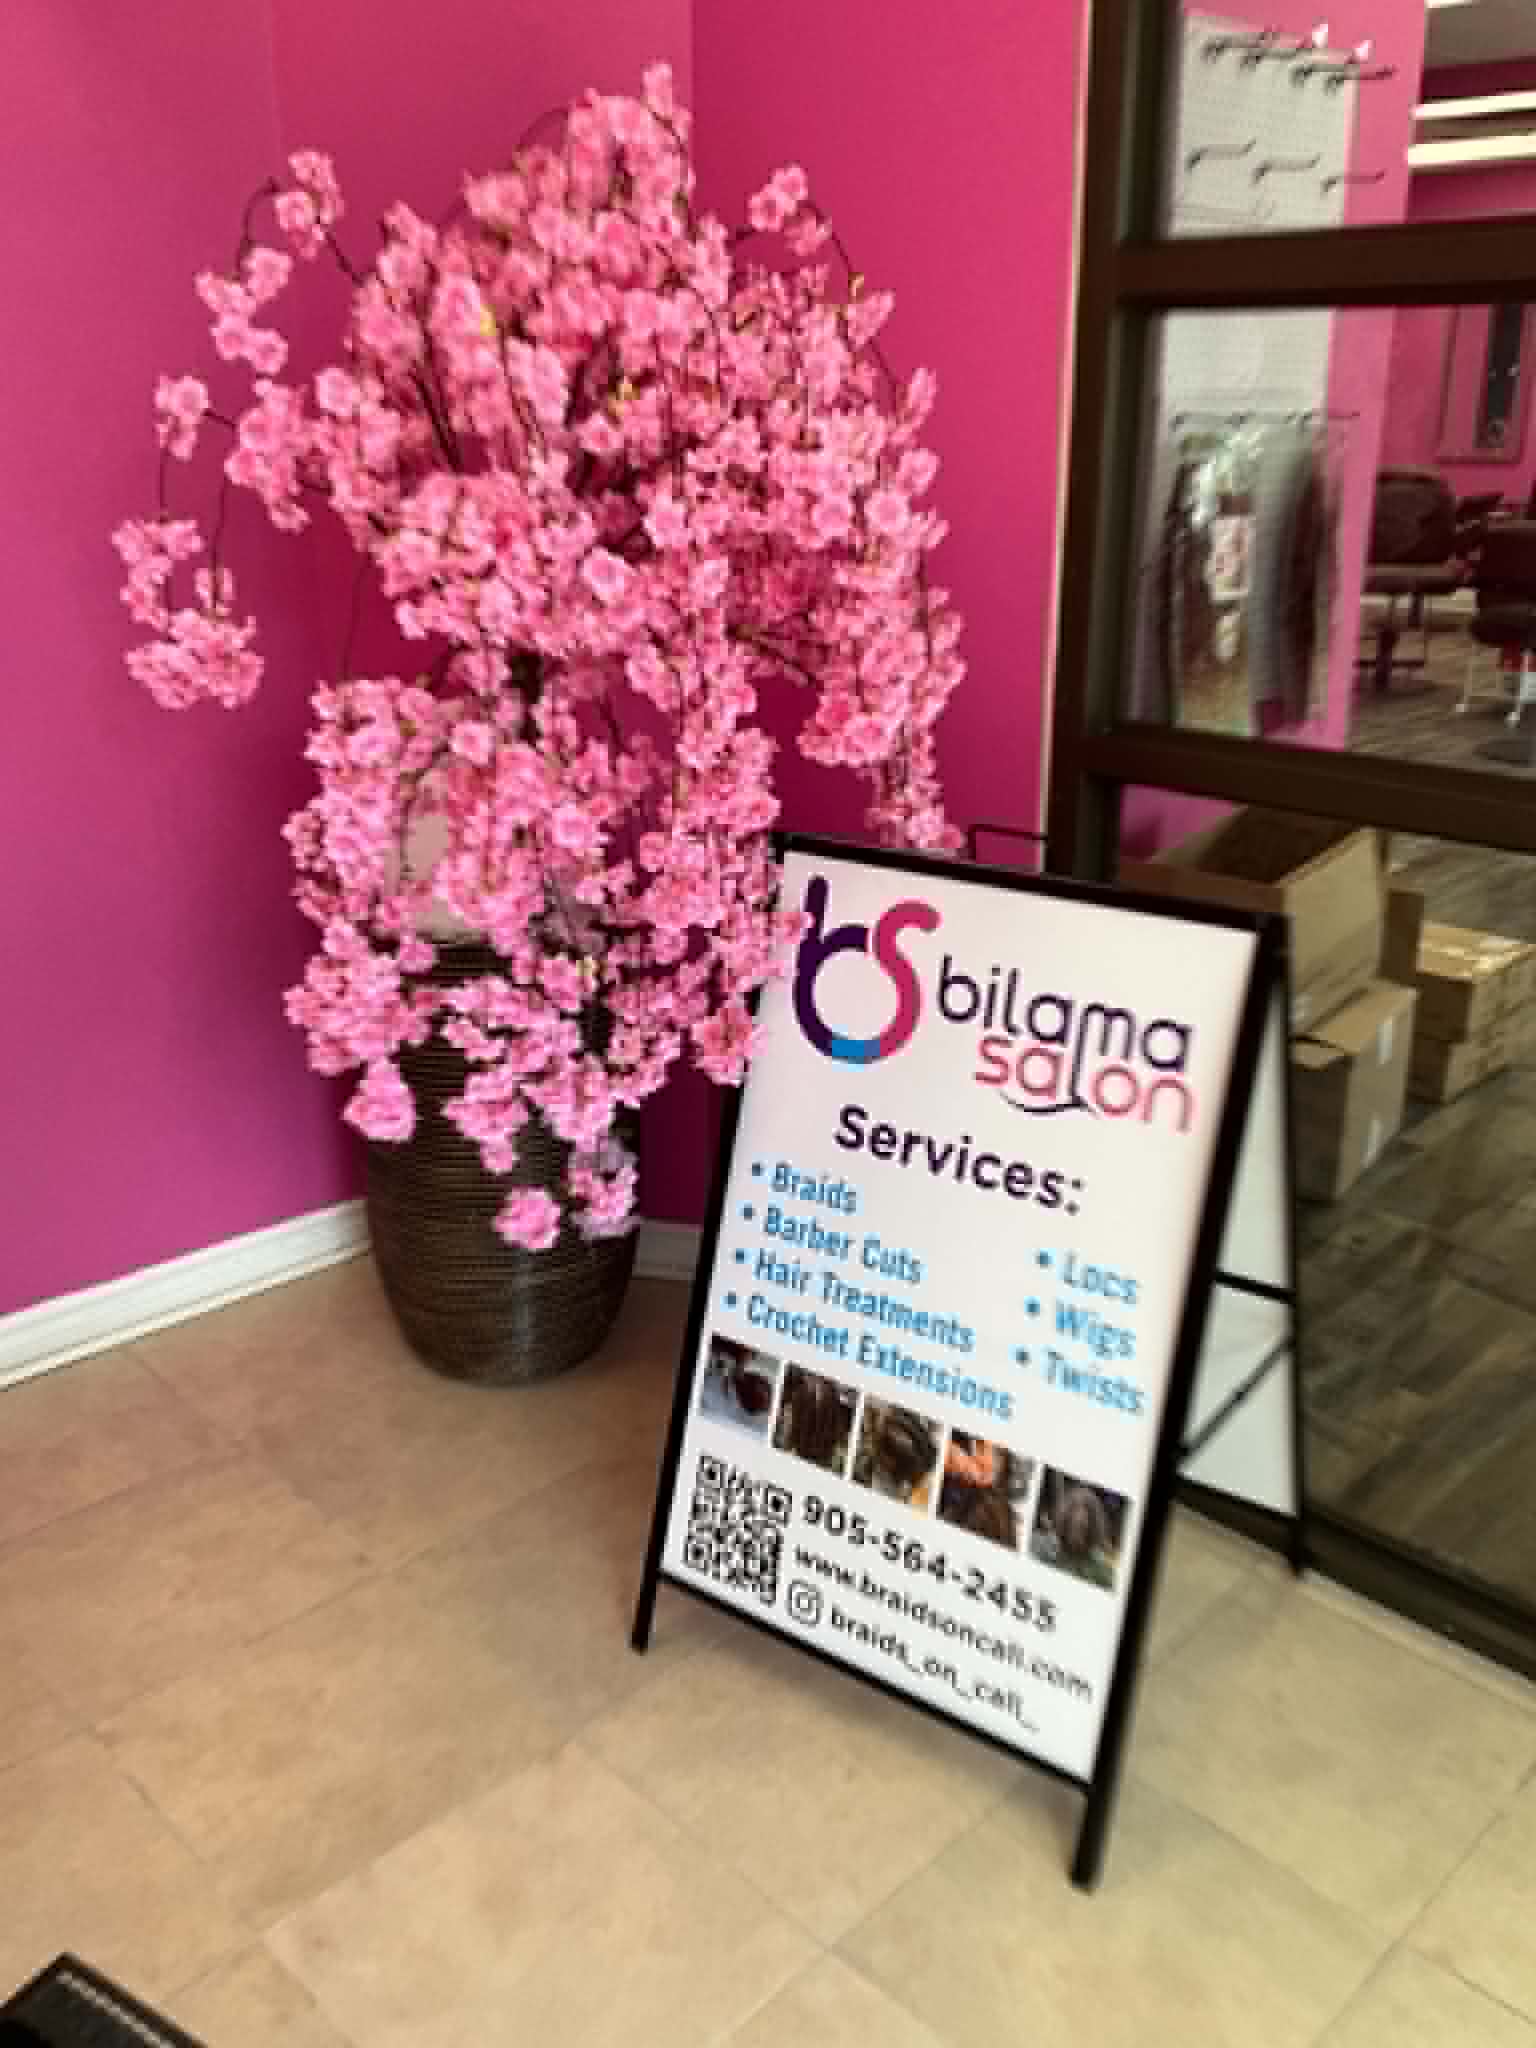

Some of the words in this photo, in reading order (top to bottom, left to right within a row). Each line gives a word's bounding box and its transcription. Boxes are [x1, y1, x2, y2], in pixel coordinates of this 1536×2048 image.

[937, 953, 1194, 1076] bilama
[973, 1030, 1194, 1133] salon
[769, 1162, 858, 1215] Braids
[833, 1104, 1085, 1215] Services:
[763, 1206, 850, 1260] Barber
[863, 1236, 923, 1285] Cuts
[1062, 1250, 1140, 1305] Locs
[754, 1248, 808, 1293] Hair
[820, 1271, 976, 1354] Treatments
[1055, 1299, 1137, 1359] Wigs
[747, 1294, 849, 1359] Crochet
[857, 1334, 1014, 1420] Extensions
[1042, 1349, 1146, 1415] Twists
[801, 1495, 1058, 1633] 905-564-2455
[795, 1544, 1093, 1704] www.braidsoncall.com
